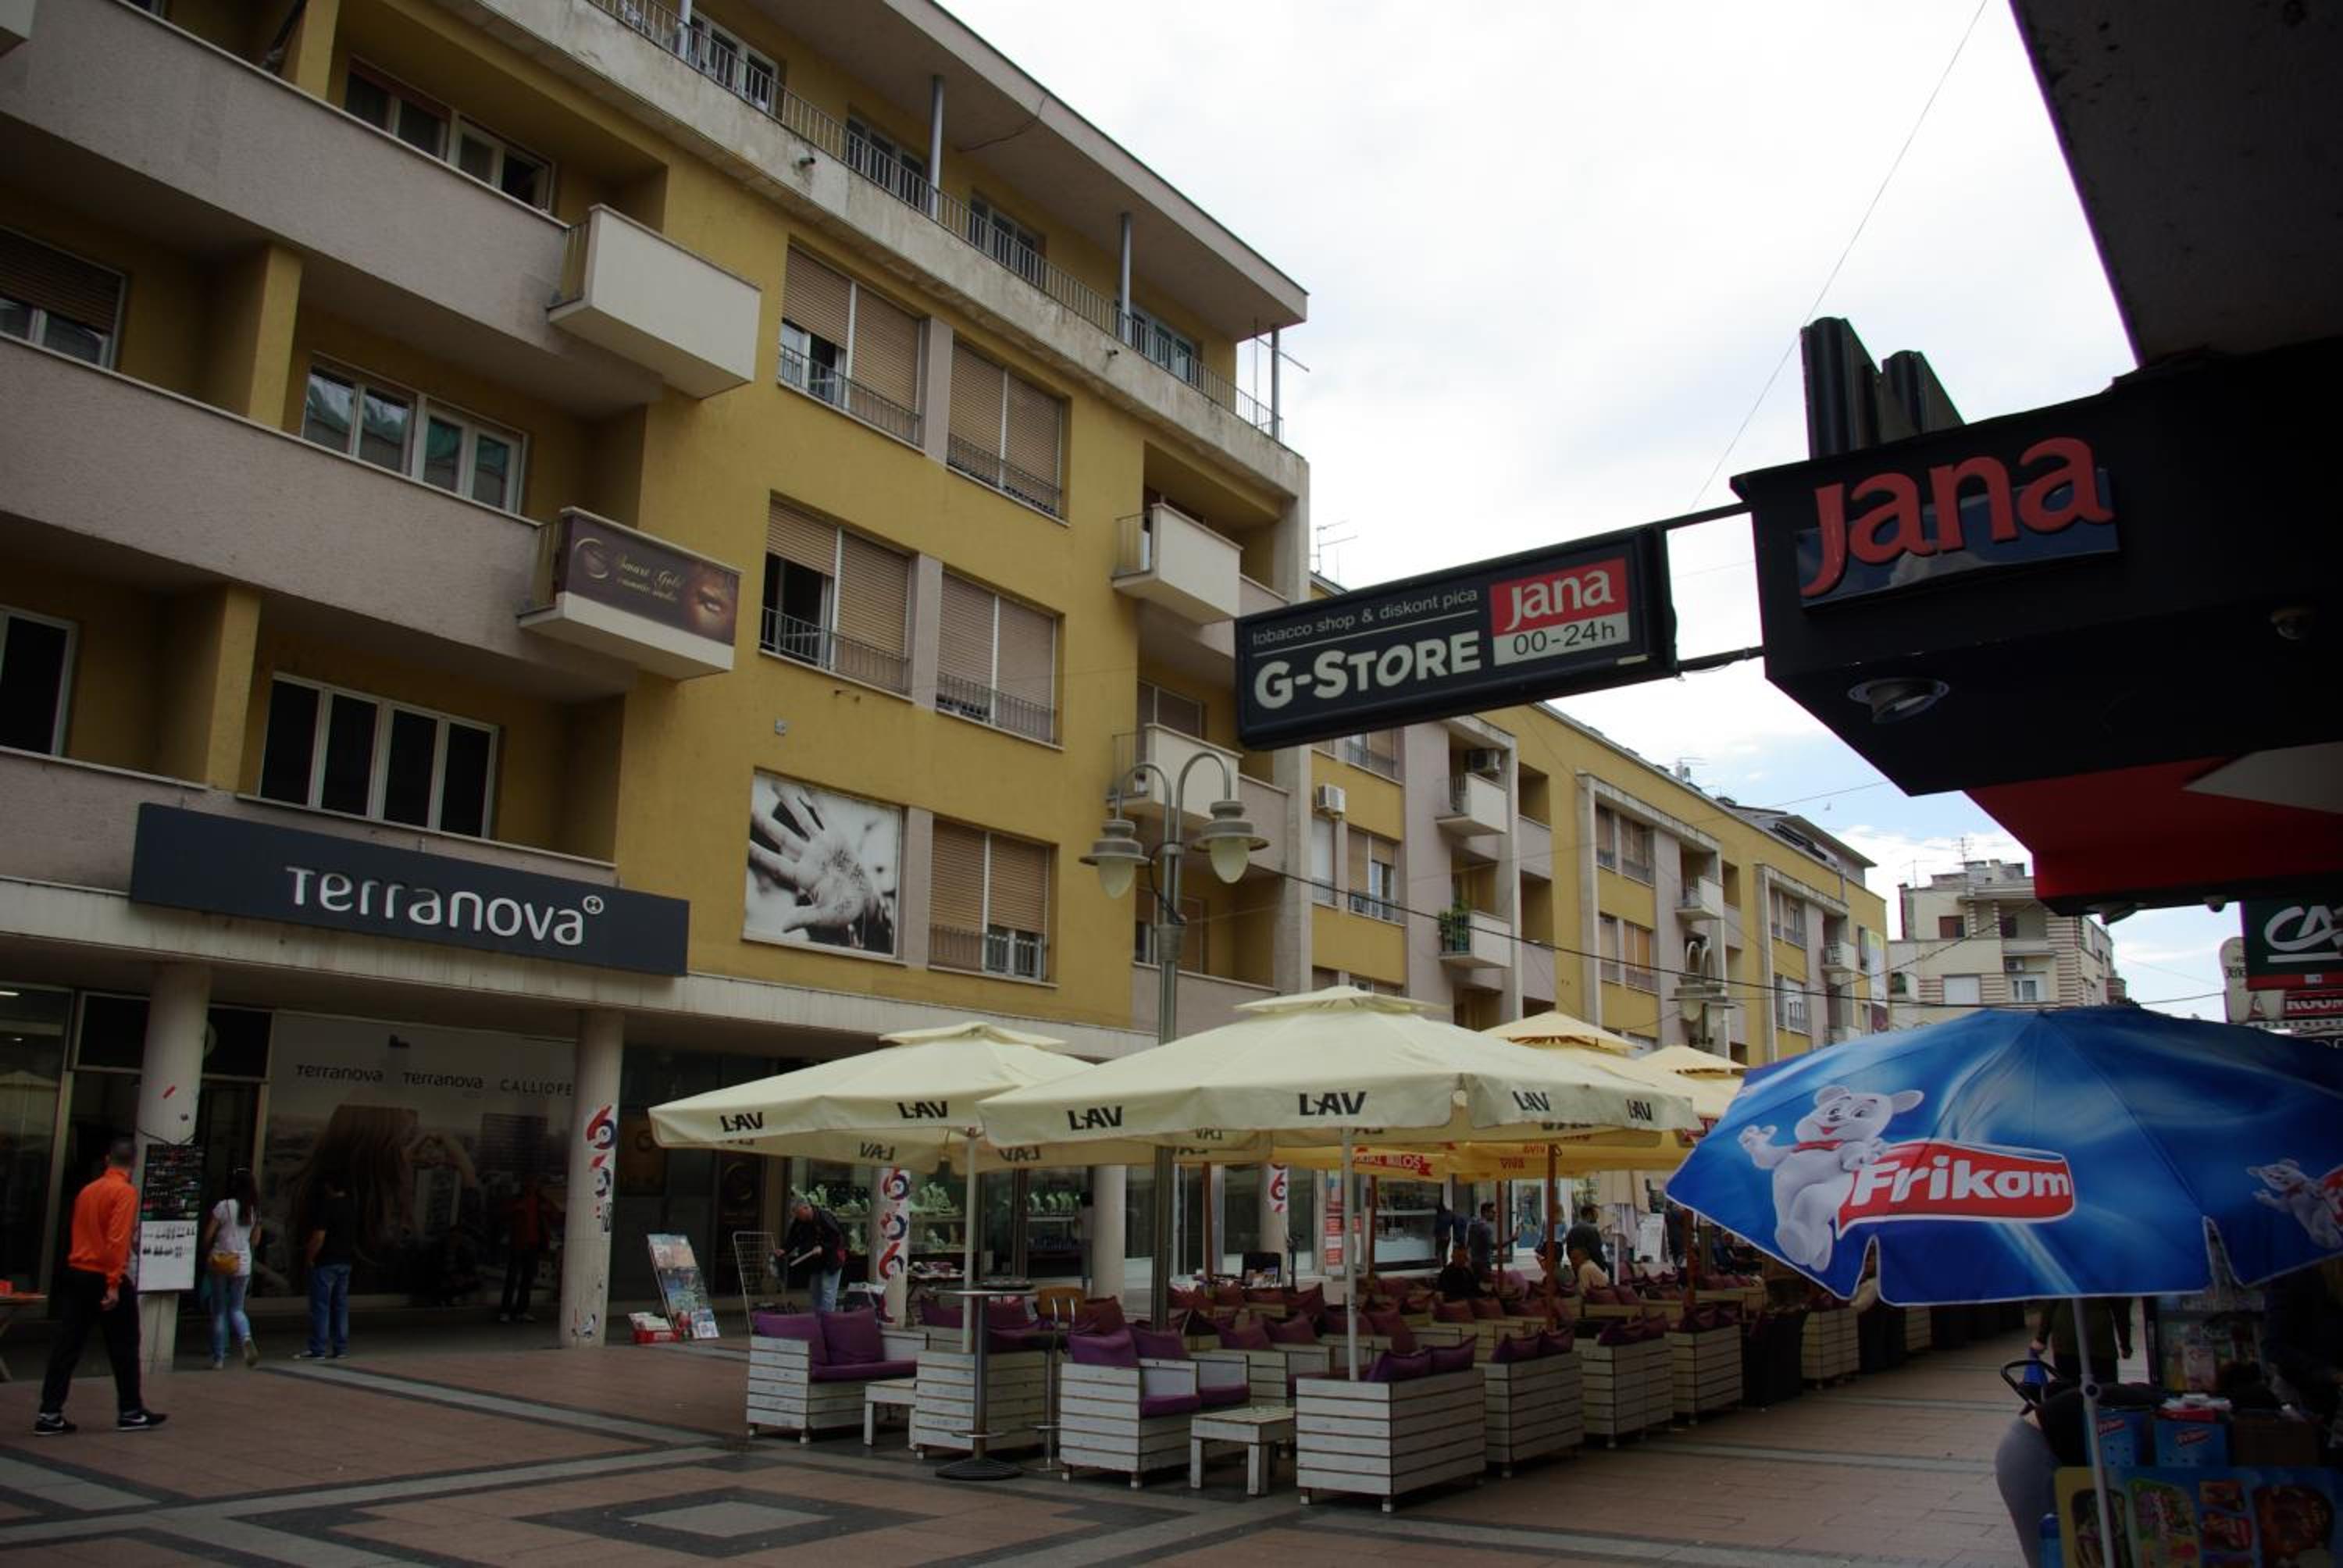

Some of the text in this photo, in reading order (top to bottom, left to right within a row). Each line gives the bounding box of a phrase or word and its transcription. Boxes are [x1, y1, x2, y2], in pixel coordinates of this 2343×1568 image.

[1252, 622, 1313, 647] tobacco
[1316, 613, 1356, 634] shop
[1361, 608, 1375, 624] &
[1379, 595, 1438, 620] diskont
[897, 1100, 948, 1118] LAV
[1299, 1091, 1366, 1115] LAV
[1512, 1091, 1550, 1112] LAV
[720, 1111, 763, 1132] LAV
[1067, 1106, 1122, 1131] LAV
[1850, 1156, 2070, 1206] Frikom
